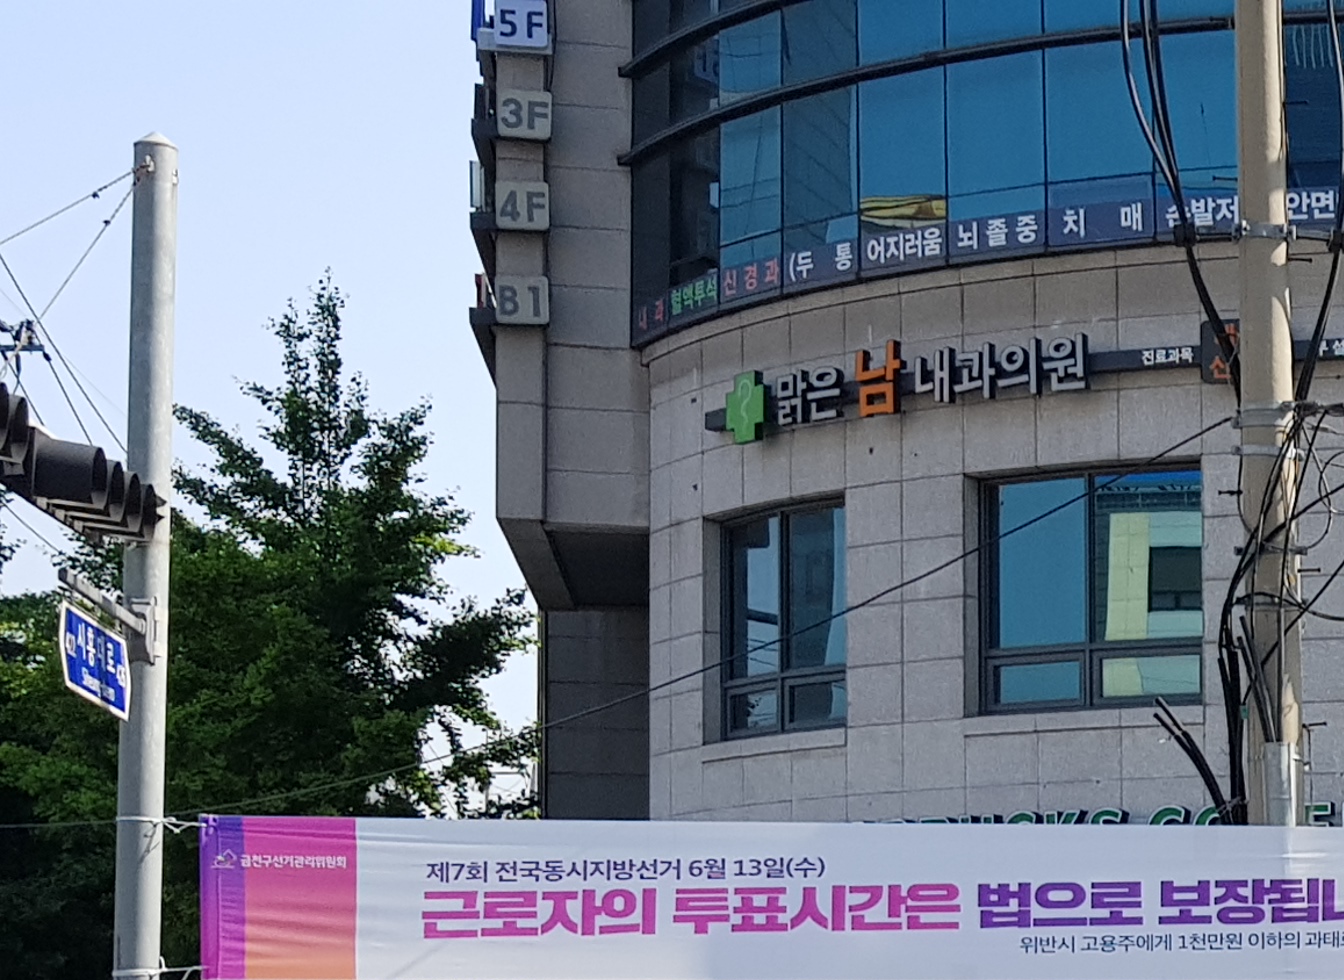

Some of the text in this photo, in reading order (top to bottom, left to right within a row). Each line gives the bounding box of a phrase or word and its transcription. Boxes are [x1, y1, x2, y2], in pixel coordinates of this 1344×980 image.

[500, 9, 543, 38] 5F
[500, 98, 549, 130] 3F
[500, 190, 548, 224] 4F
[670, 276, 718, 316] 혈액투석
[867, 228, 943, 264] 어지러움
[1165, 196, 1239, 229] 손발저
[501, 284, 544, 319] B1
[1141, 346, 1195, 365] 진료과목
[777, 333, 1088, 426] 맑은 남 내과의원
[426, 855, 826, 884] 제7회 전국동시지방선거 6월 13일(수)
[421, 887, 657, 939] 근로자의
[672, 884, 961, 935] 투표시간은
[976, 881, 1144, 929] 법으로
[1019, 936, 1076, 955] 위반시
[1080, 933, 1174, 953] 고용주에게
[1177, 931, 1244, 951] 1천만원
[1247, 929, 1302, 950] 이하의
